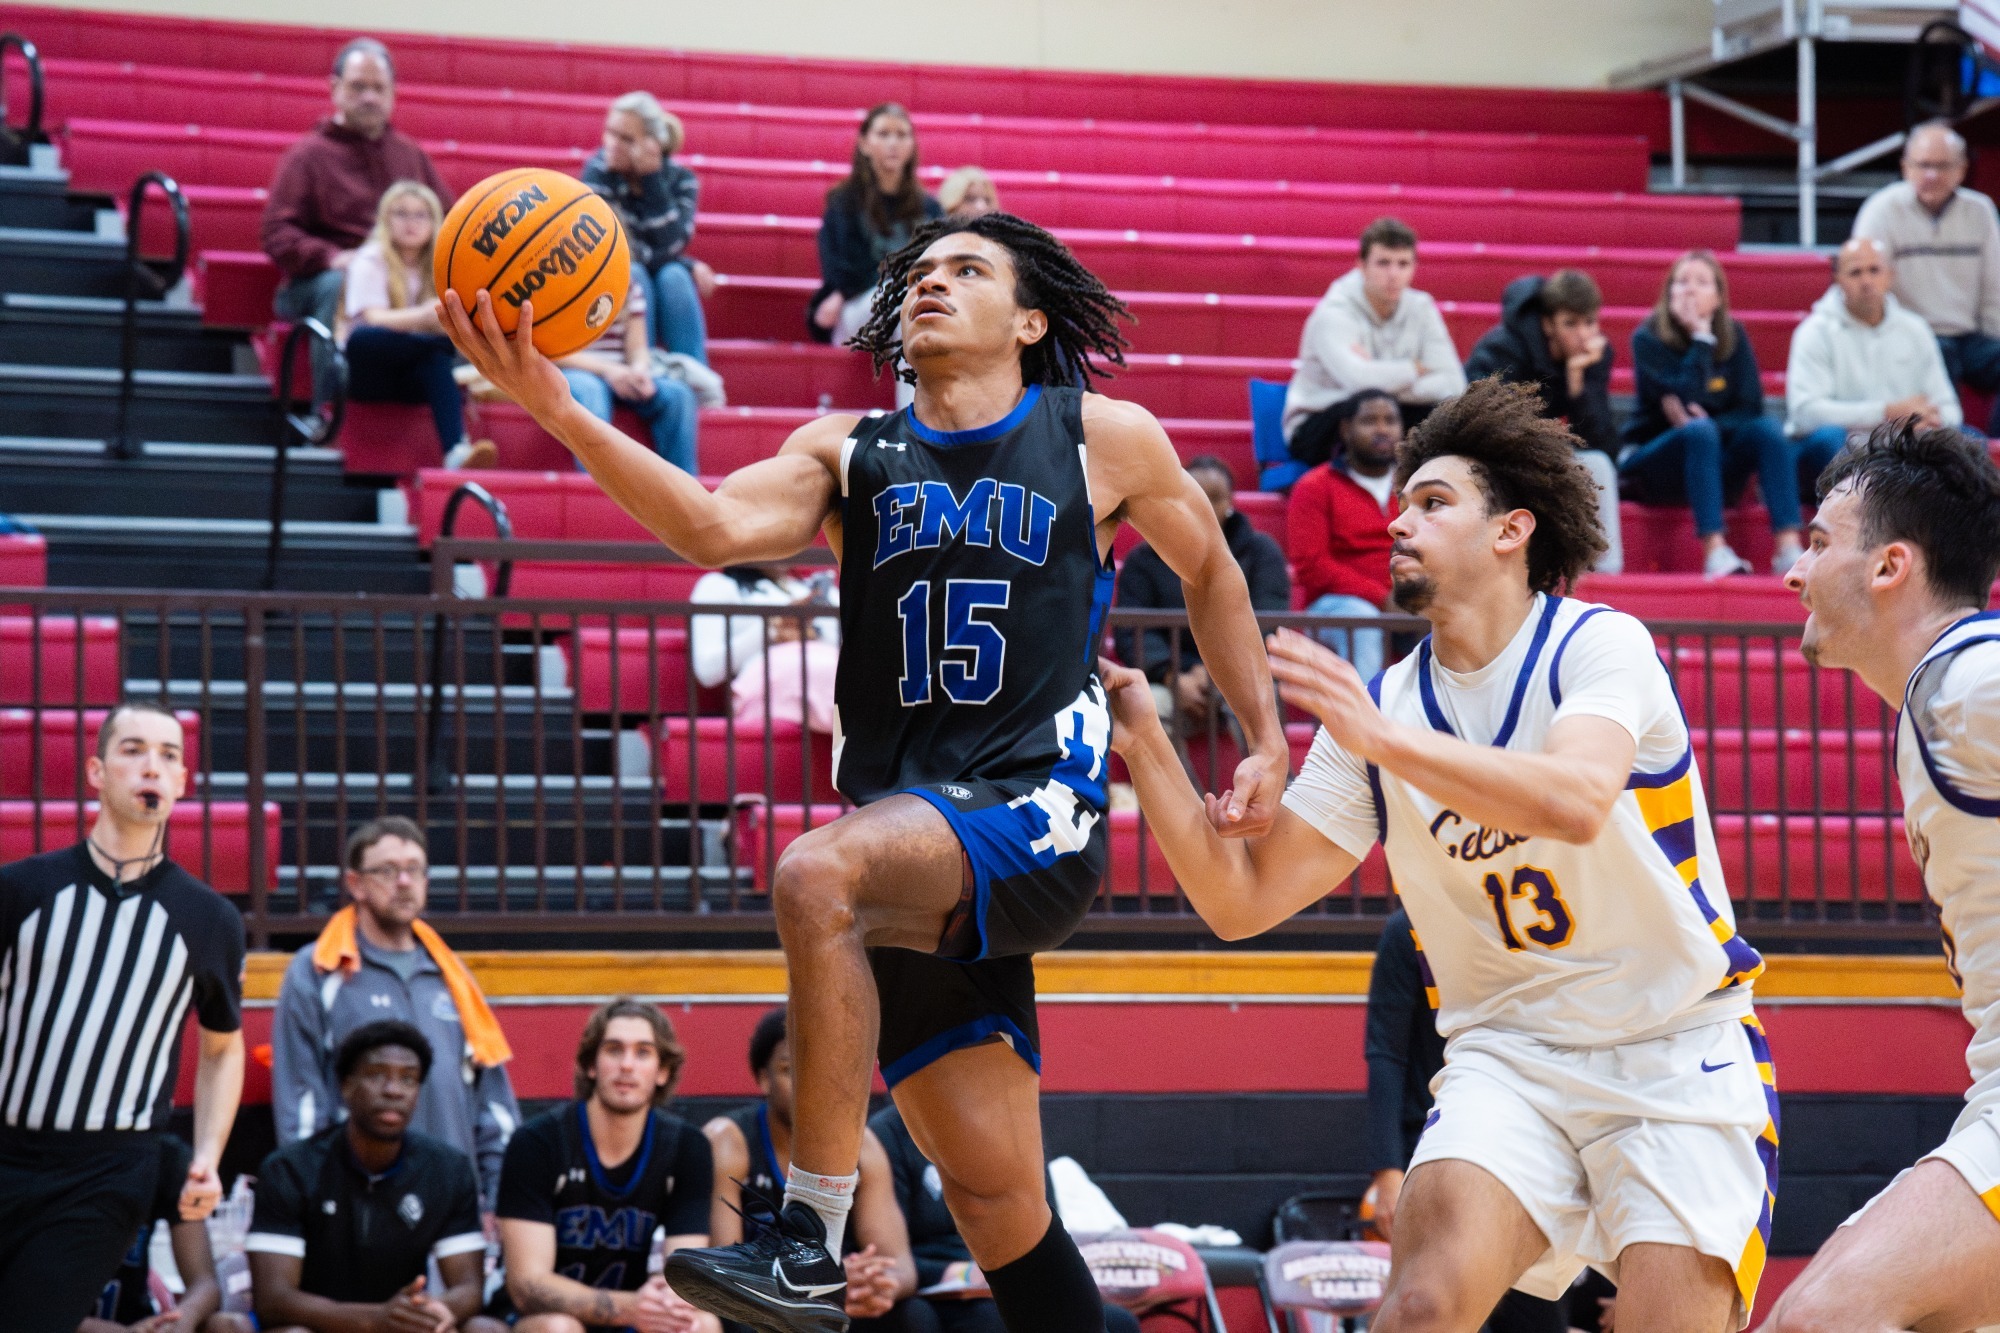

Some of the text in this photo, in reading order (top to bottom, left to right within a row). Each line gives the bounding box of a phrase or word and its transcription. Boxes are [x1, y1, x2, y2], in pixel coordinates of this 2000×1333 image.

[472, 184, 549, 259] NCAA
[501, 212, 607, 309] Wilson
[873, 477, 1056, 571] EMU
[898, 579, 1011, 707] 15
[1482, 864, 1576, 953] 13
[557, 1203, 657, 1251] EMU
